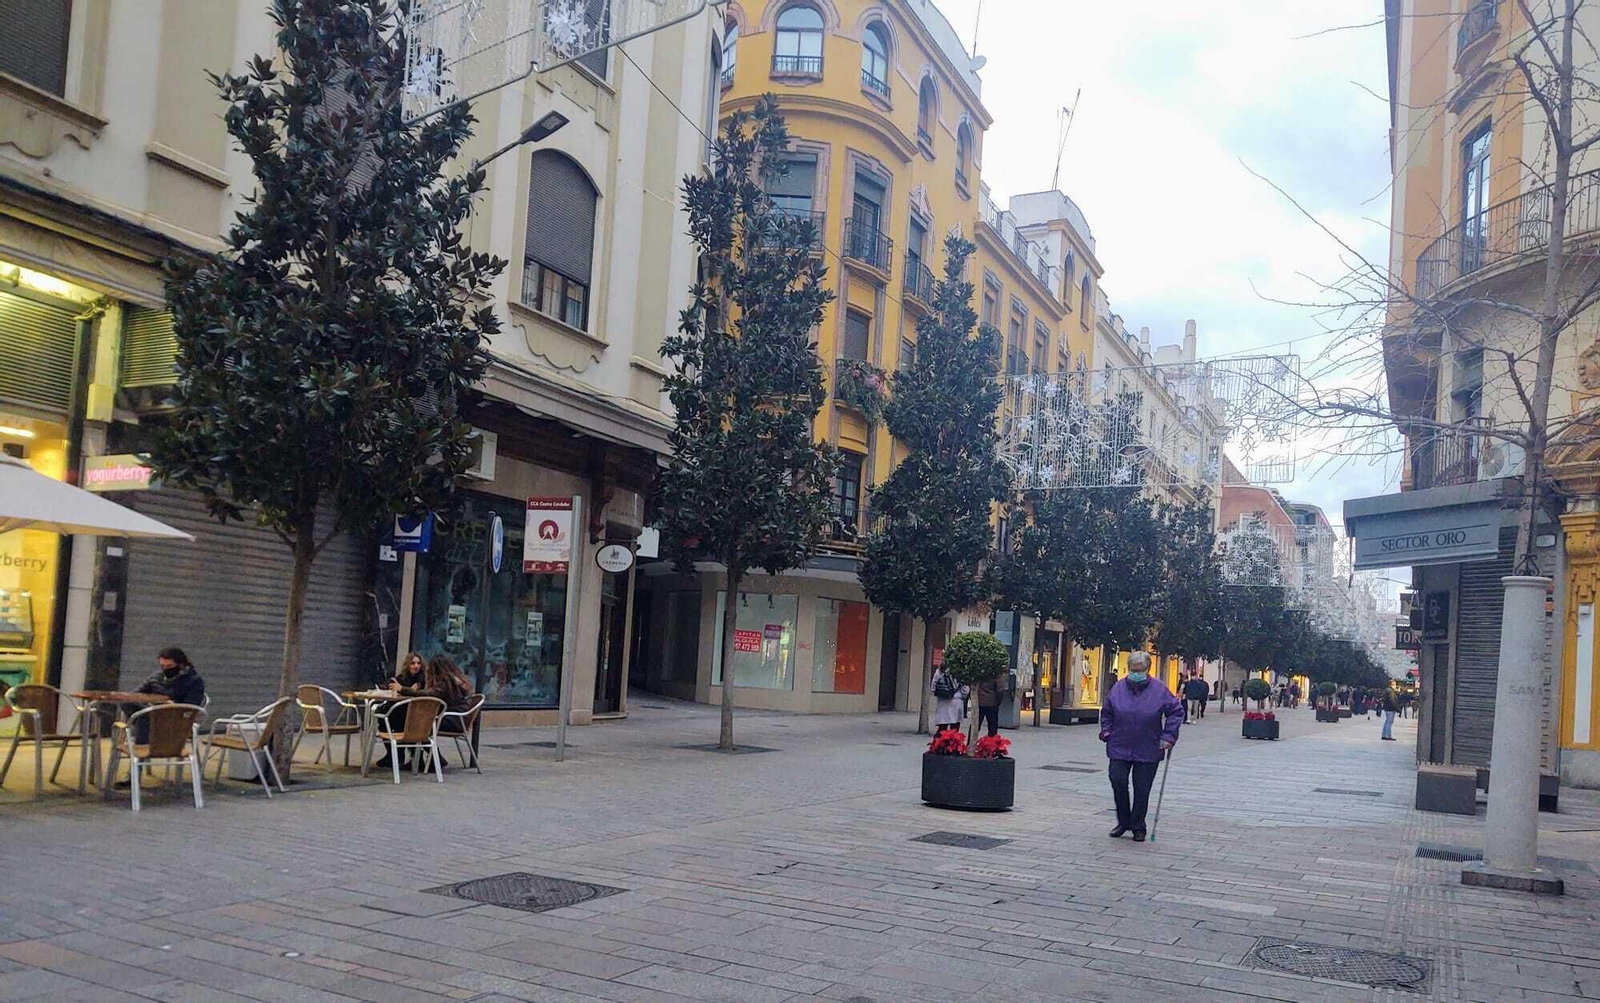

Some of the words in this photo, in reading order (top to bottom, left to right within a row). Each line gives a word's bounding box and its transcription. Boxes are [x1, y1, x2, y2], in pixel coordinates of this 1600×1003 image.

[86, 465, 148, 484] yogurberry
[1382, 535, 1429, 551] SECTOR
[1436, 531, 1466, 546] ORO
